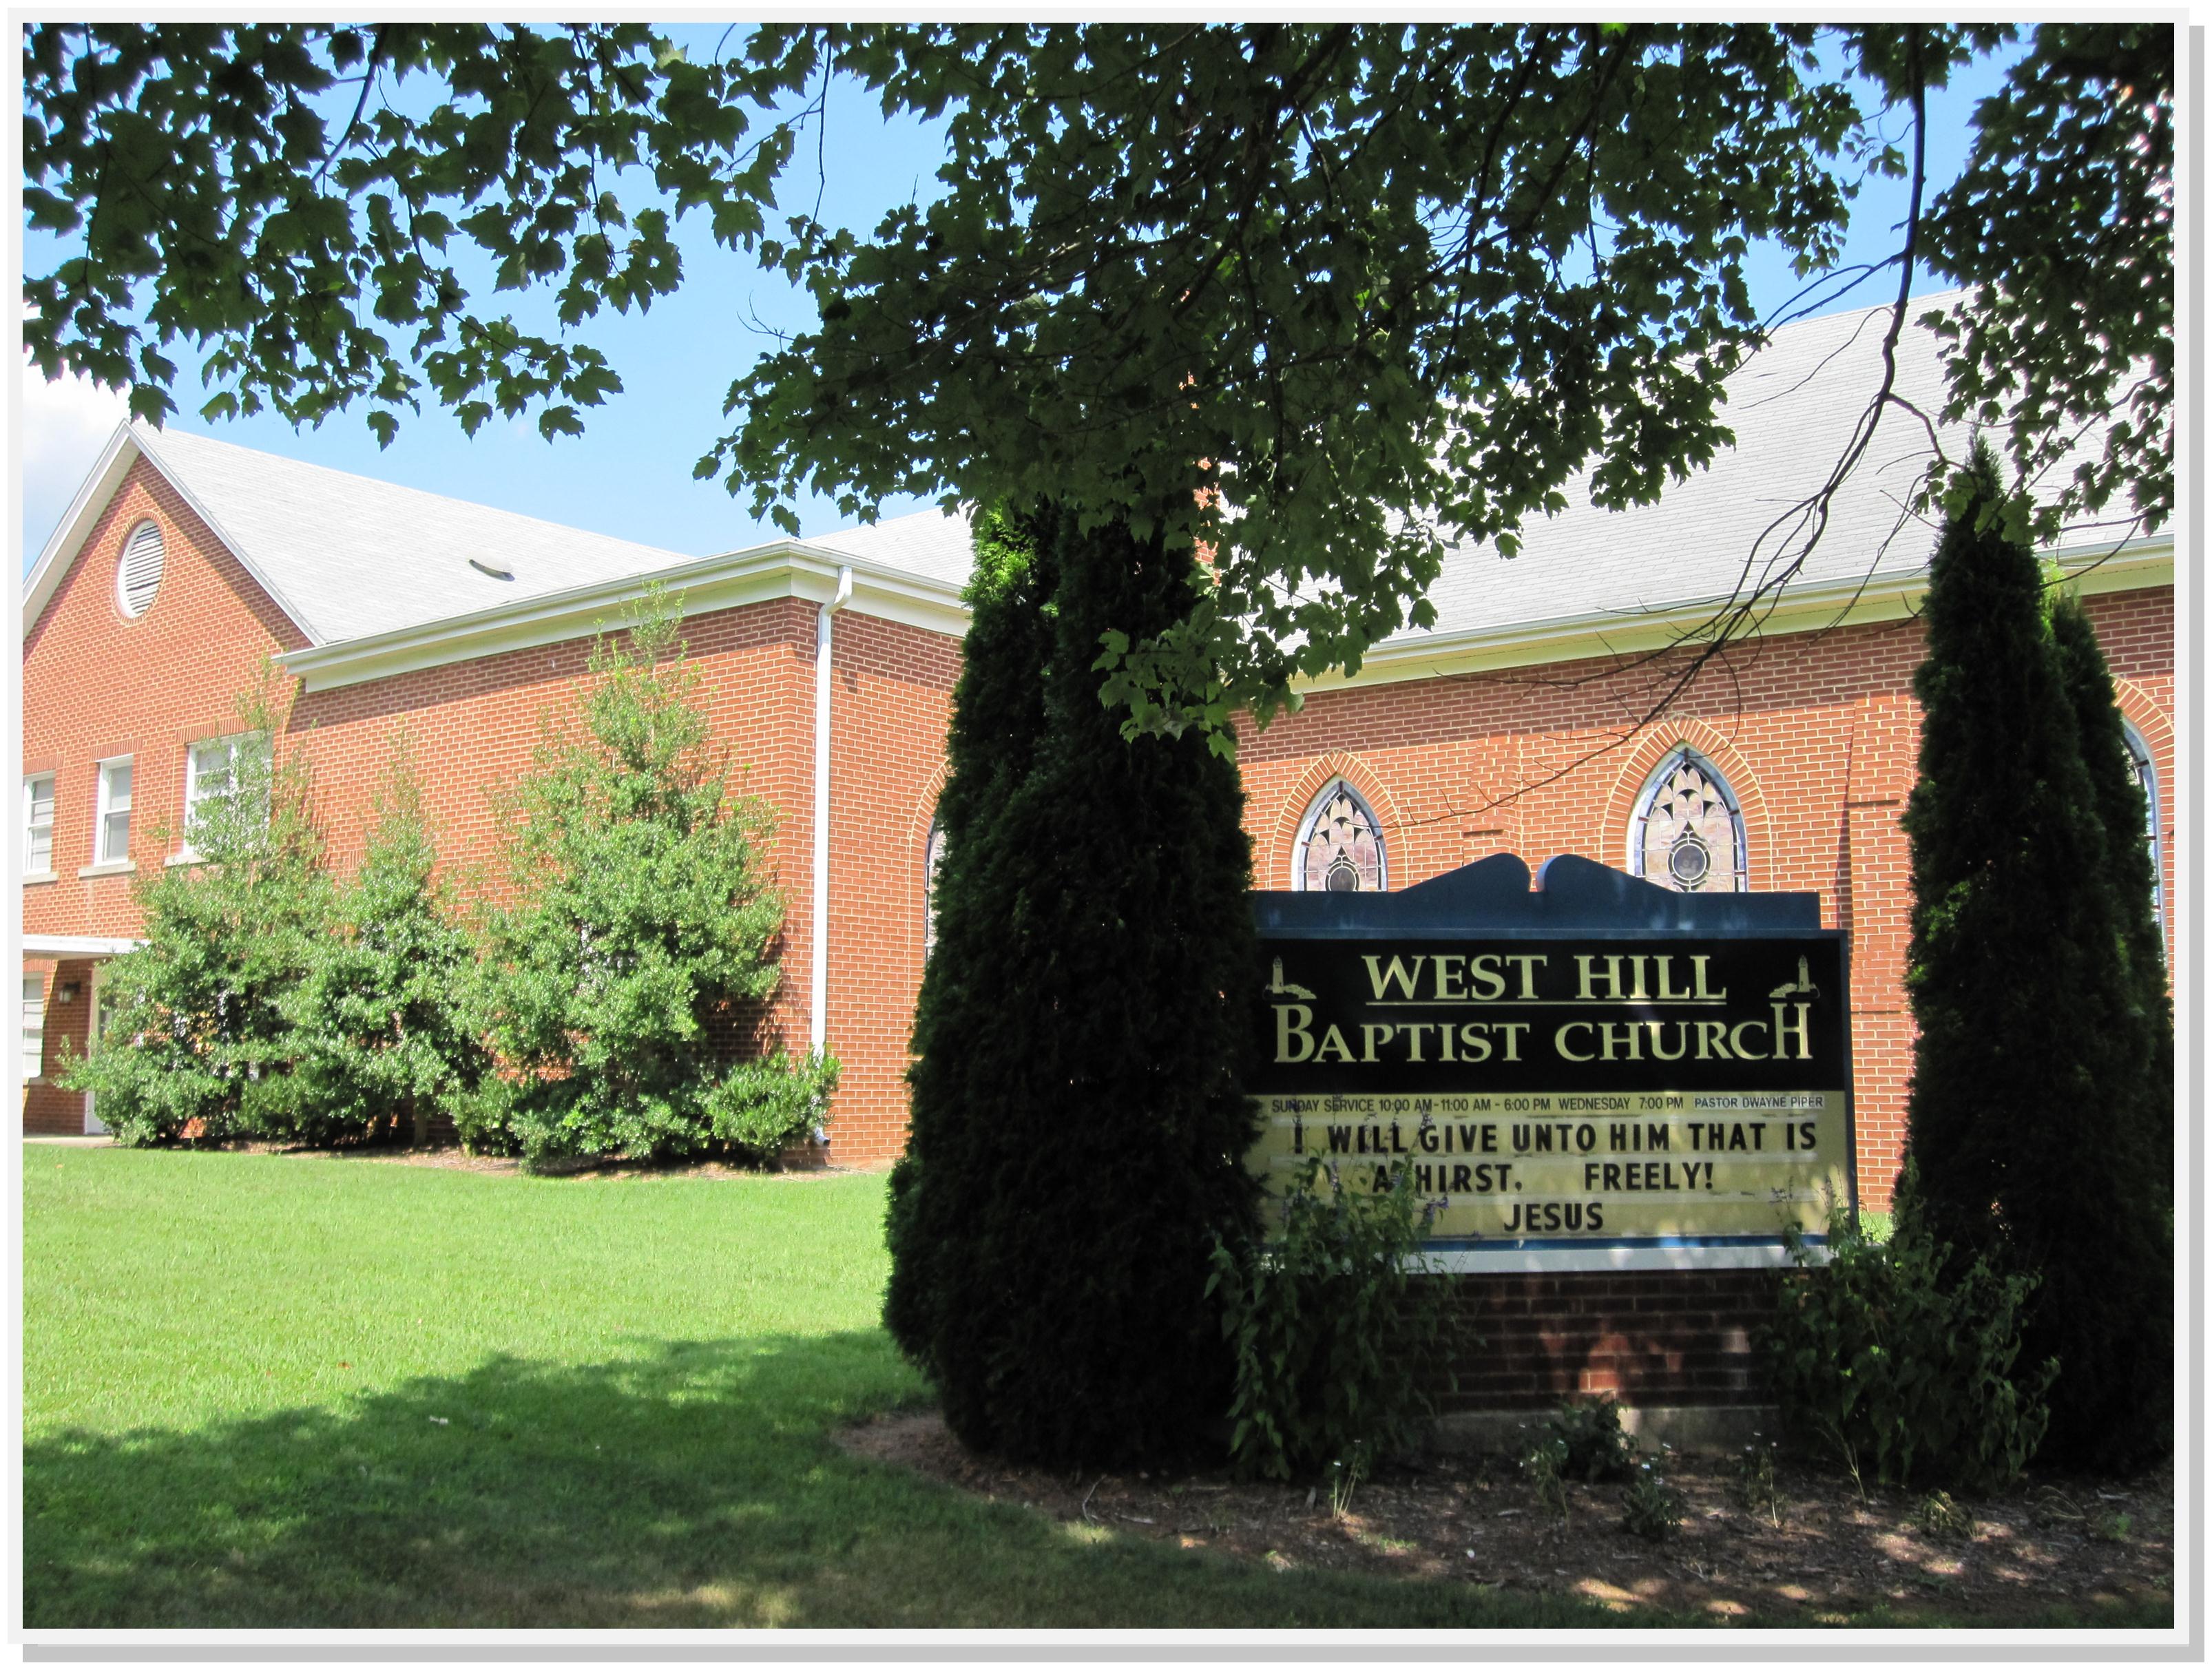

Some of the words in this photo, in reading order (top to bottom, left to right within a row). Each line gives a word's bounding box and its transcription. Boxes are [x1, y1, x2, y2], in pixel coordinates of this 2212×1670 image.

[1361, 954, 1548, 1001] WEST
[1574, 955, 1727, 999] HILL
[1271, 1004, 1530, 1063] BAPTIST
[1554, 1002, 1813, 1062] CHURCH
[1272, 1099, 1319, 1113] SUNDAY
[1324, 1099, 1375, 1112] SERVICE
[1379, 1098, 1410, 1112] 10:00
[1472, 1098, 1491, 1111] AM
[1504, 1098, 1530, 1111] 6:00
[1533, 1098, 1550, 1111] PM
[1558, 1097, 1630, 1111] WEDNESDAY
[1639, 1097, 1663, 1109] 7:00
[1667, 1097, 1684, 1109] PM
[1695, 1097, 1738, 1108] PASTOR
[1742, 1096, 1786, 1108] DWAYNE
[1791, 1096, 1824, 1107] PIPER
[1295, 1125, 1303, 1154] I
[1327, 1125, 1409, 1154] WILL
[1419, 1124, 1498, 1153] GIVE
[1512, 1123, 1596, 1152] UNTO
[1609, 1123, 1669, 1151] HIM
[1687, 1123, 1766, 1151] THAT
[1786, 1122, 1817, 1150] IS
[1585, 1162, 1714, 1191] FREELY!
[1503, 1202, 1604, 1232] JESUS
